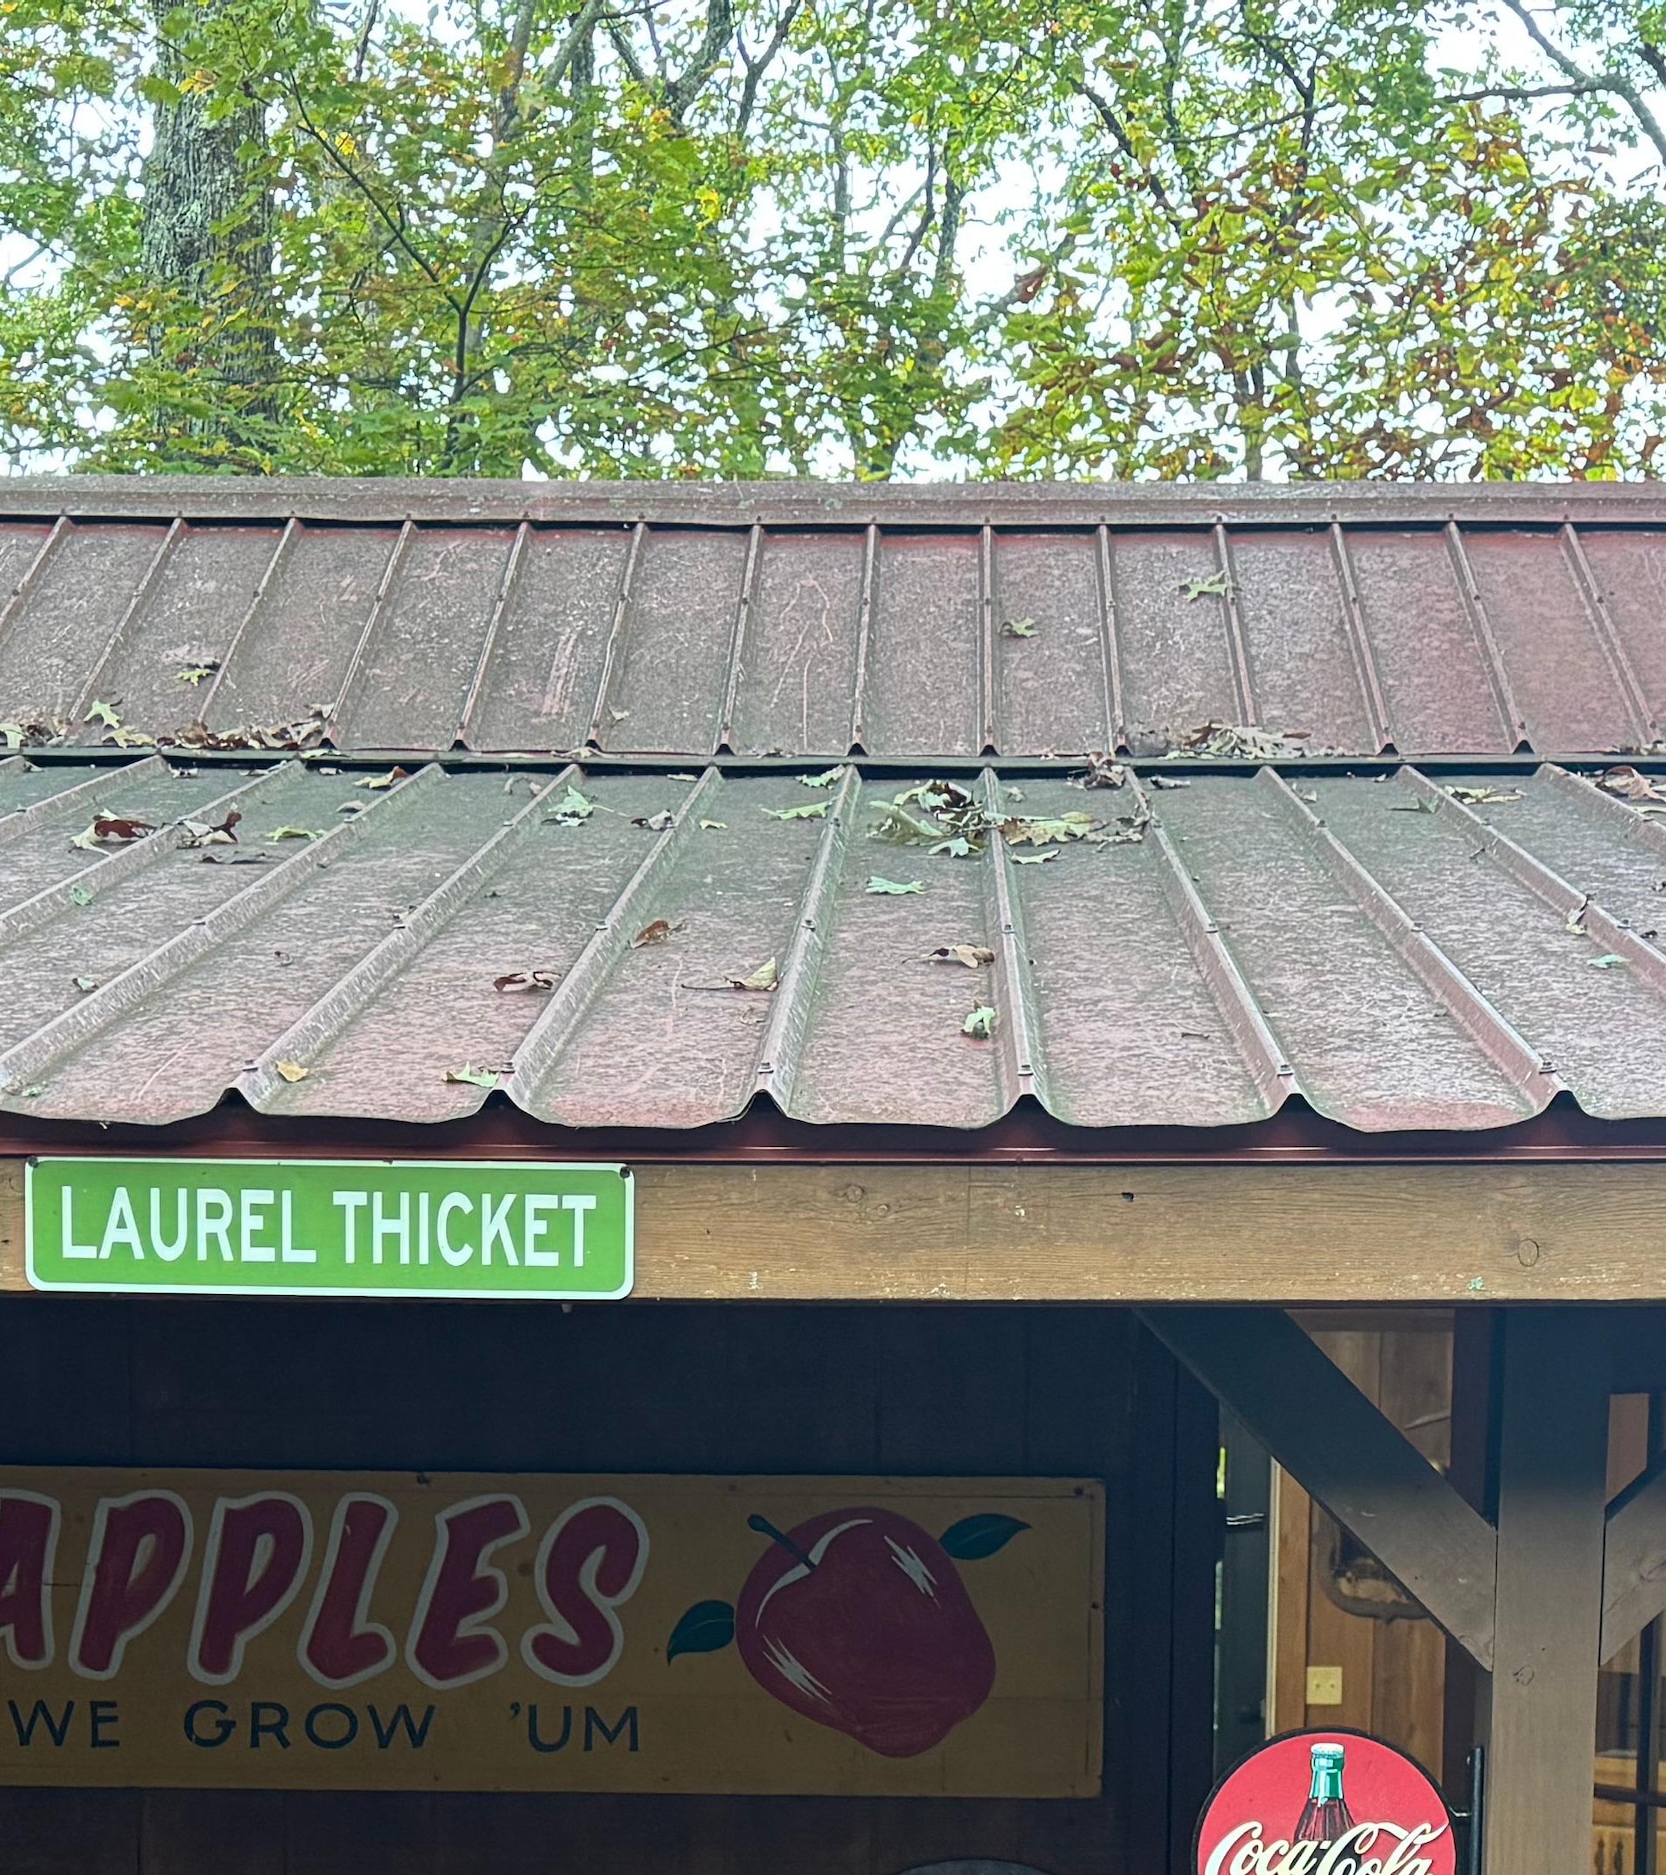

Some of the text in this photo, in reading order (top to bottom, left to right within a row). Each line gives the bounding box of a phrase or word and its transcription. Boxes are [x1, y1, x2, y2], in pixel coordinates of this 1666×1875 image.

[61, 1185, 597, 1267] LAUREL THICKET
[8, 1699, 641, 1752] WE GROW 'UM
